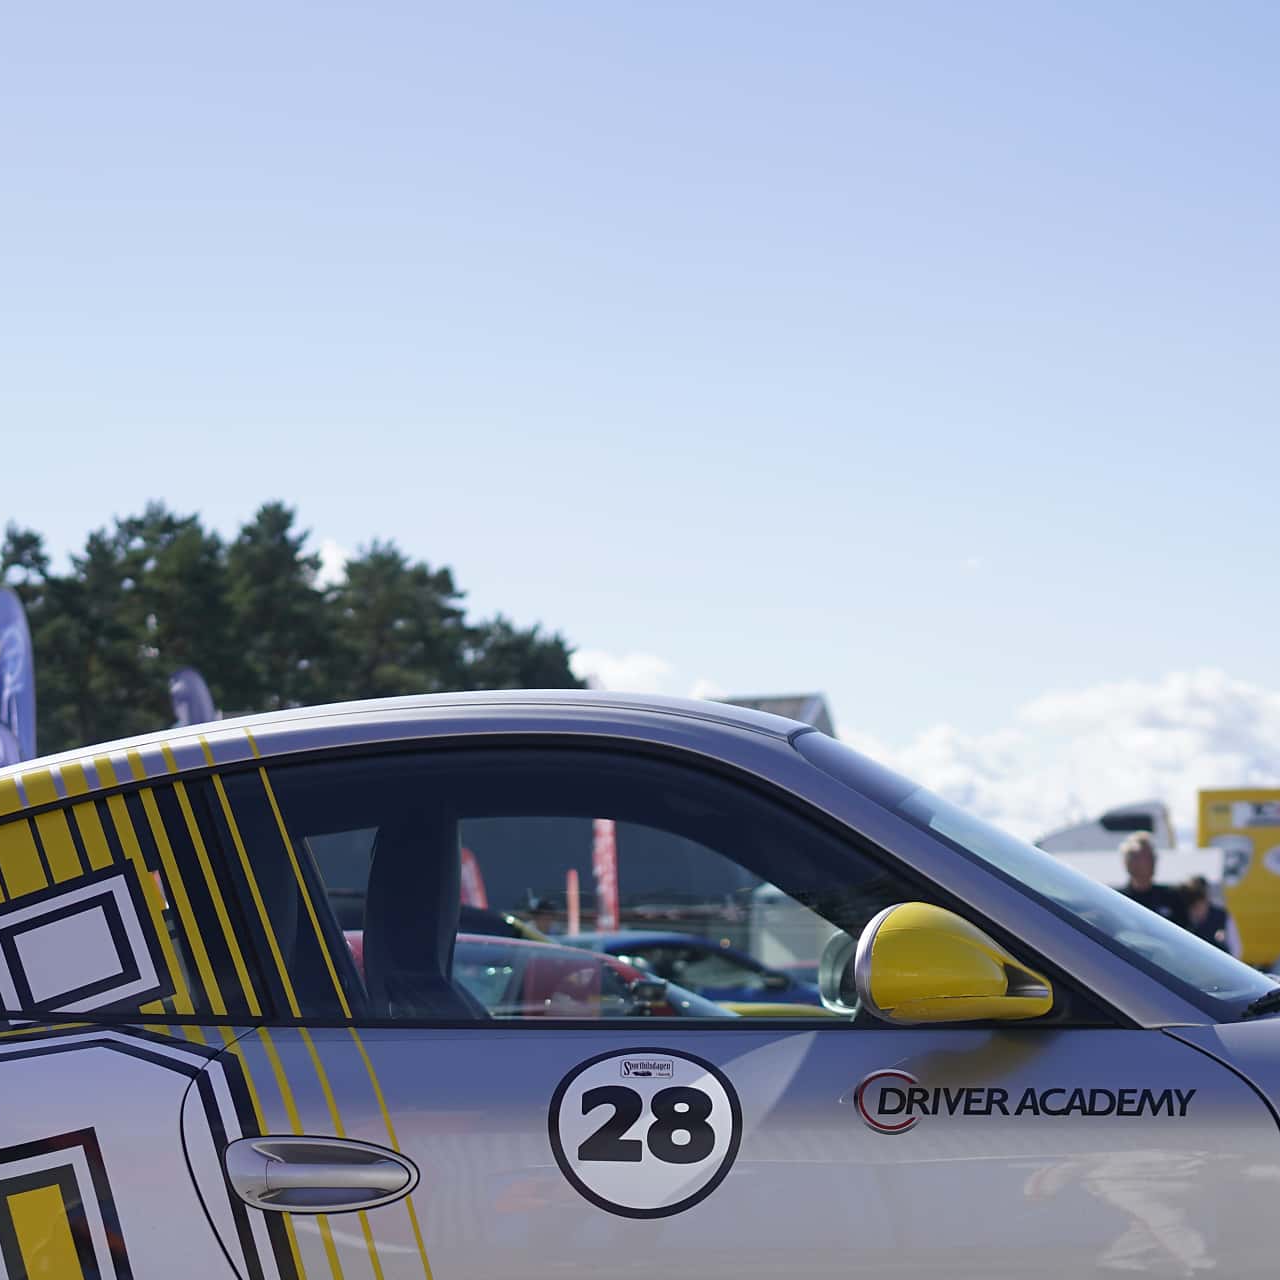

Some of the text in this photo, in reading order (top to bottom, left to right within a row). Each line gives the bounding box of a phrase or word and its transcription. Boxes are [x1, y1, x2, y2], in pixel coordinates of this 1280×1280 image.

[578, 1085, 716, 1165] 28
[877, 1087, 1197, 1116] DRIVER ACADEMY
